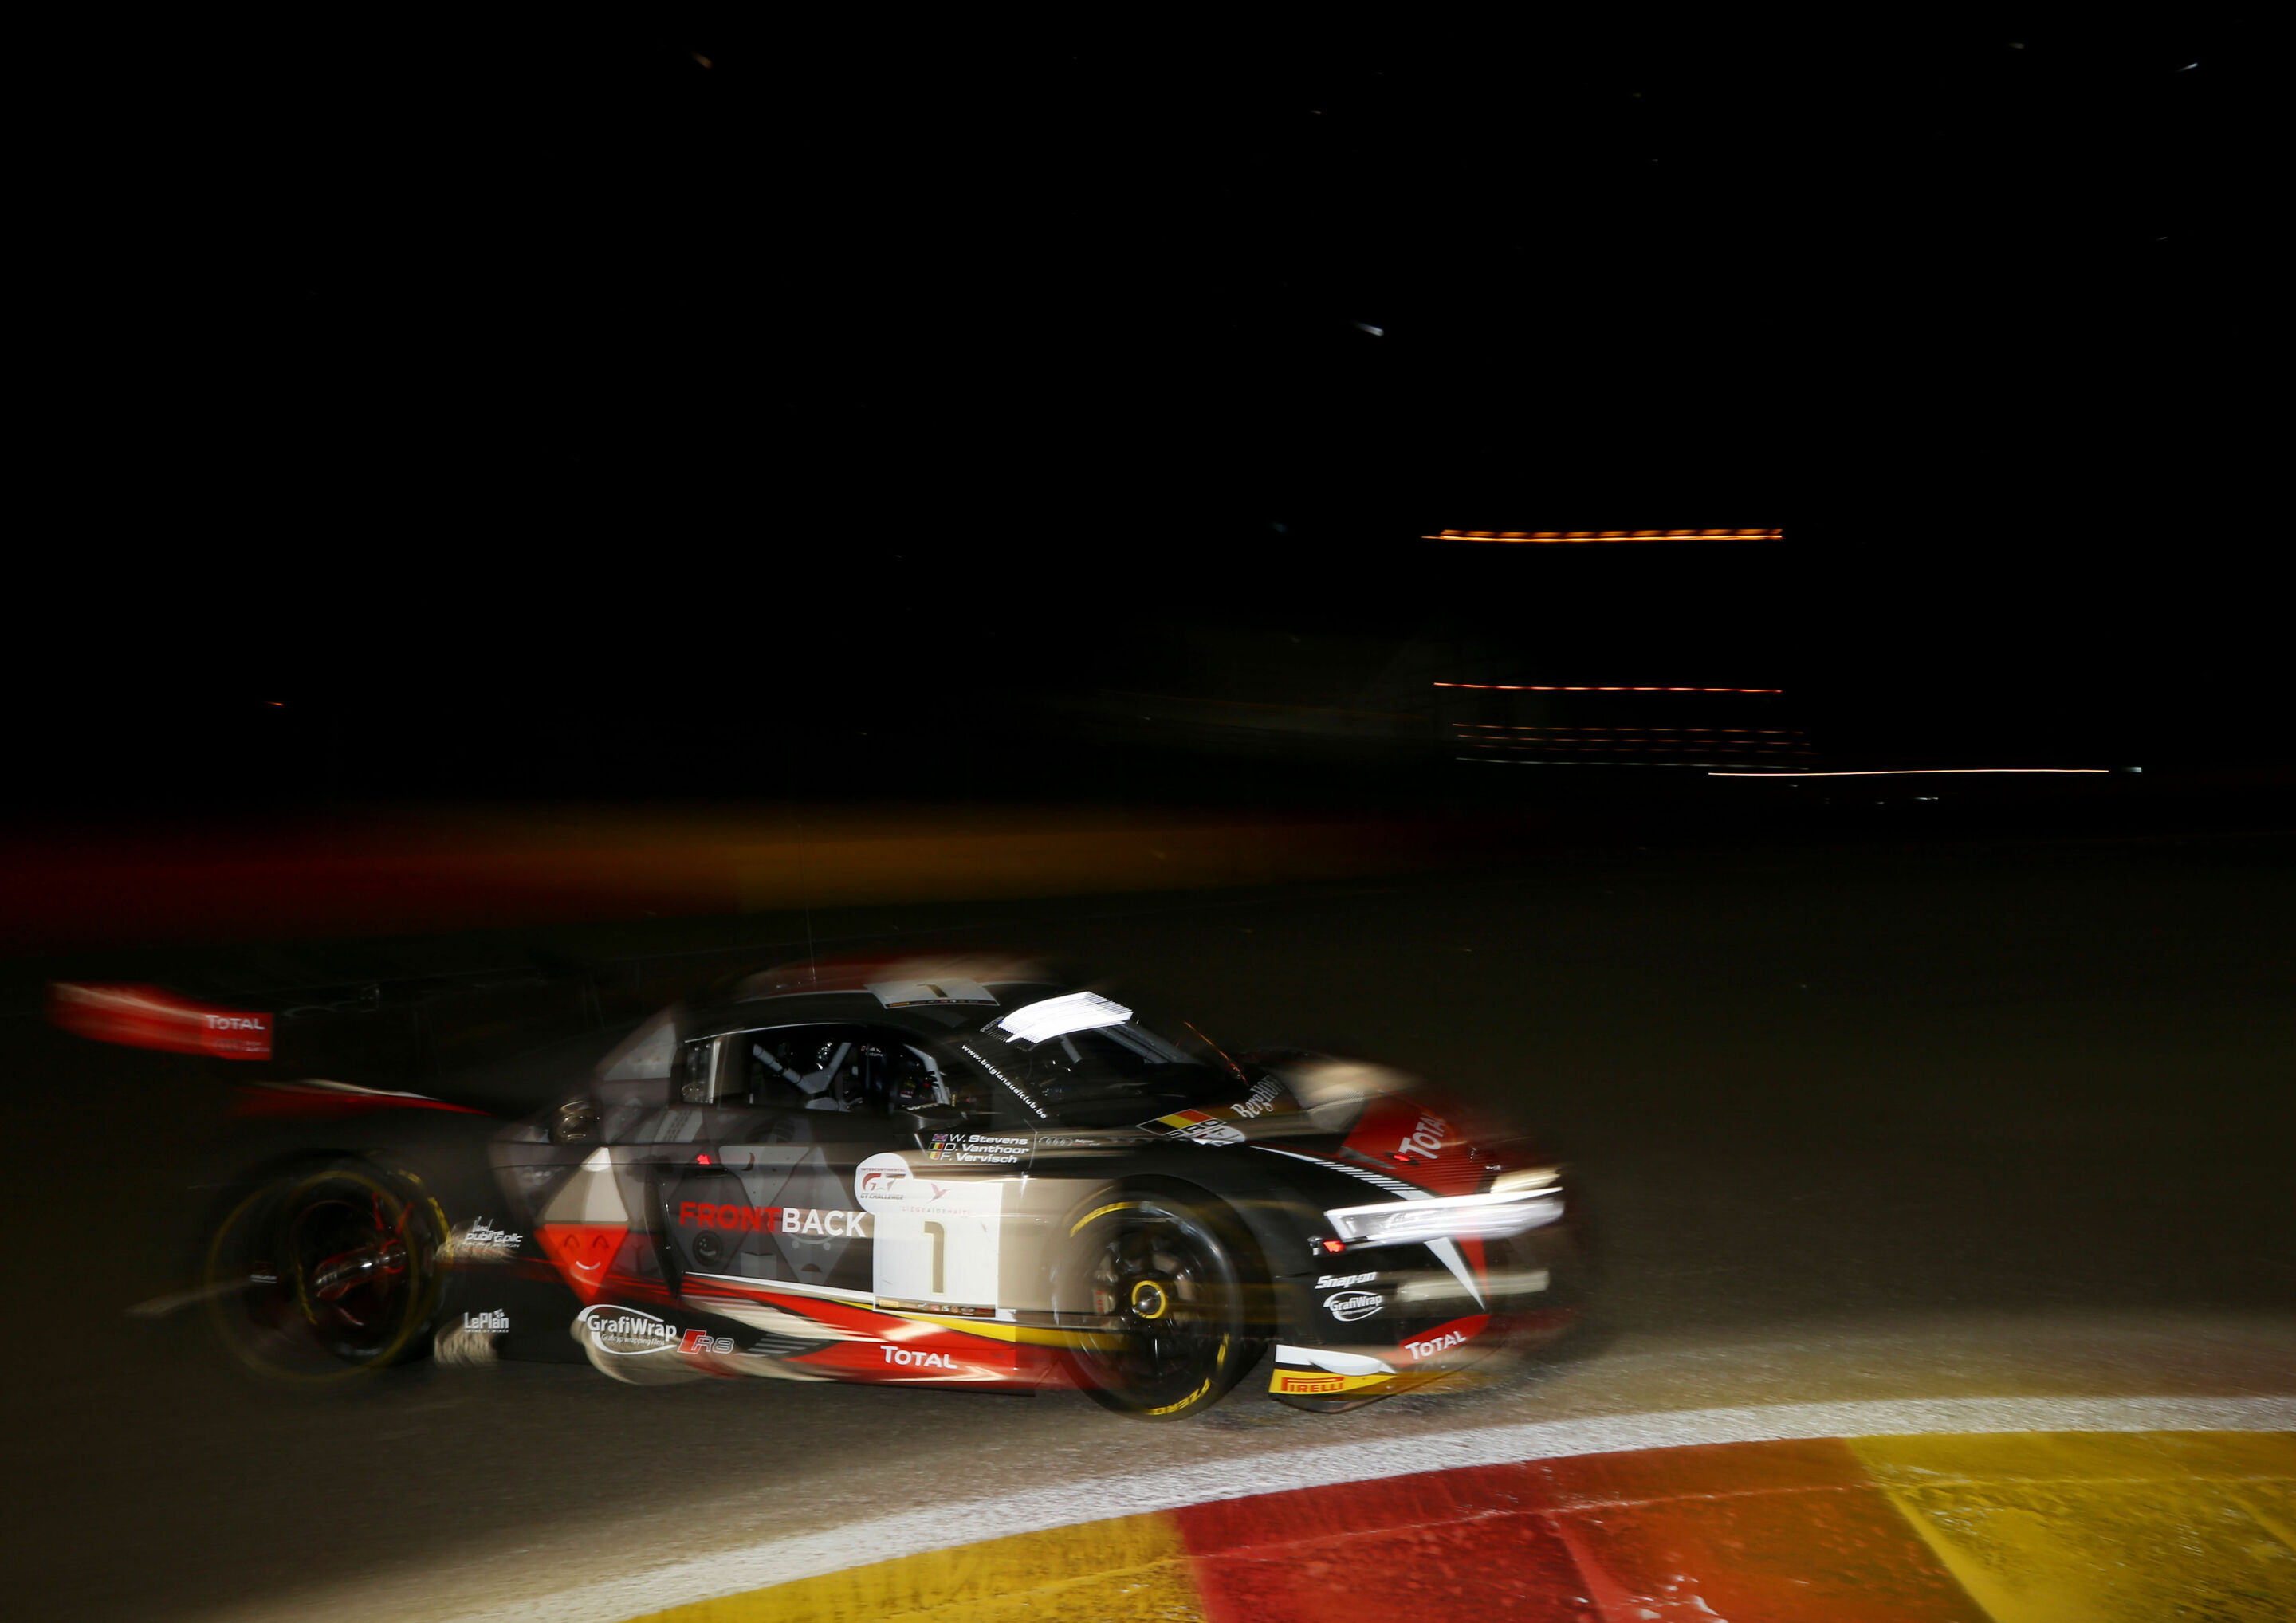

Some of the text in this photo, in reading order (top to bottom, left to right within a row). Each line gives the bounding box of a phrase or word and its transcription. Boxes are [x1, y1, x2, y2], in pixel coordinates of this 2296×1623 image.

[205, 1014, 266, 1030] TOTAL
[961, 1044, 1048, 1119] www.belgianaudiclub.be
[943, 1143, 1029, 1154] D. Vanthoor
[949, 1134, 1028, 1146] W. Stevens
[940, 1152, 1018, 1164] F. Vervisch
[923, 1220, 946, 1295] 1
[1315, 1271, 1378, 1289] Snap-on
[1330, 1295, 1383, 1311] GrafiWrap
[587, 1315, 677, 1342] GrafiWrap
[1404, 1330, 1467, 1360] TOTAL
[879, 1344, 957, 1370] TOTAL
[1281, 1376, 1345, 1392] PIRELLI
